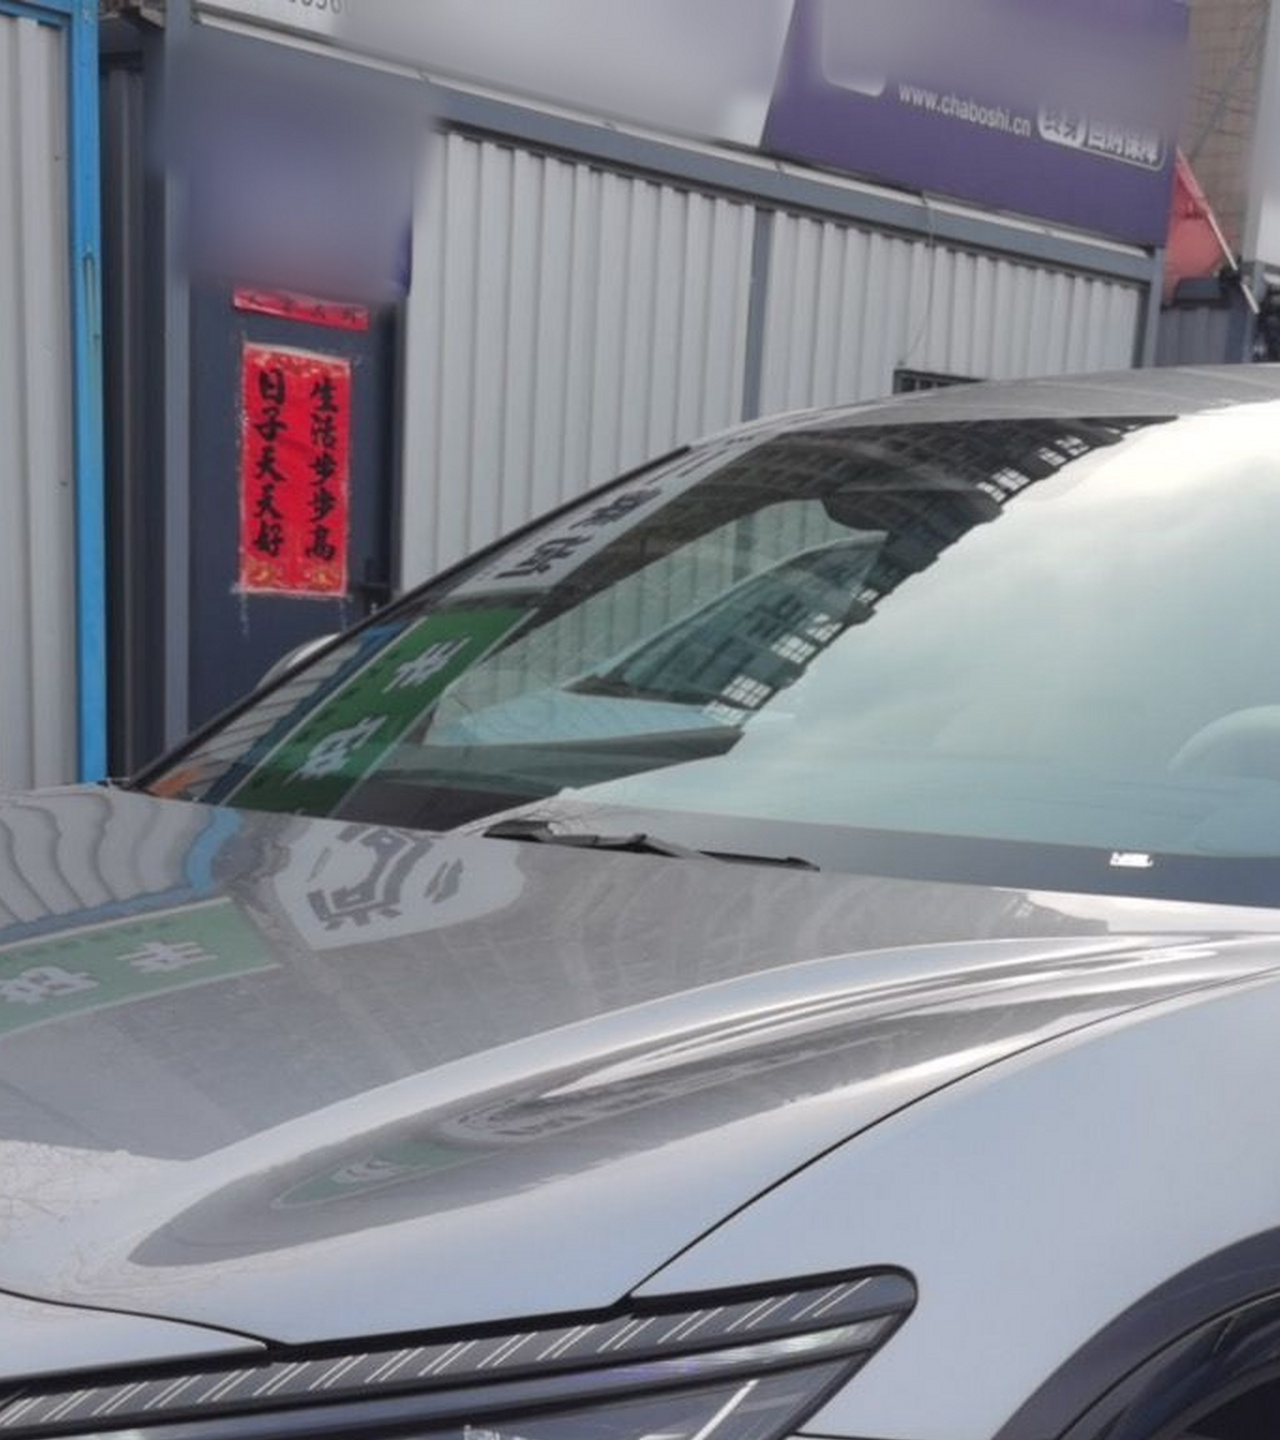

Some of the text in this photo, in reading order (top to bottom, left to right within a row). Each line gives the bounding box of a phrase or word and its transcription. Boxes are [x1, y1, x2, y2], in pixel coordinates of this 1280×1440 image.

[251, 368, 288, 558] 日子天天好
[303, 375, 340, 561] 生活步步高
